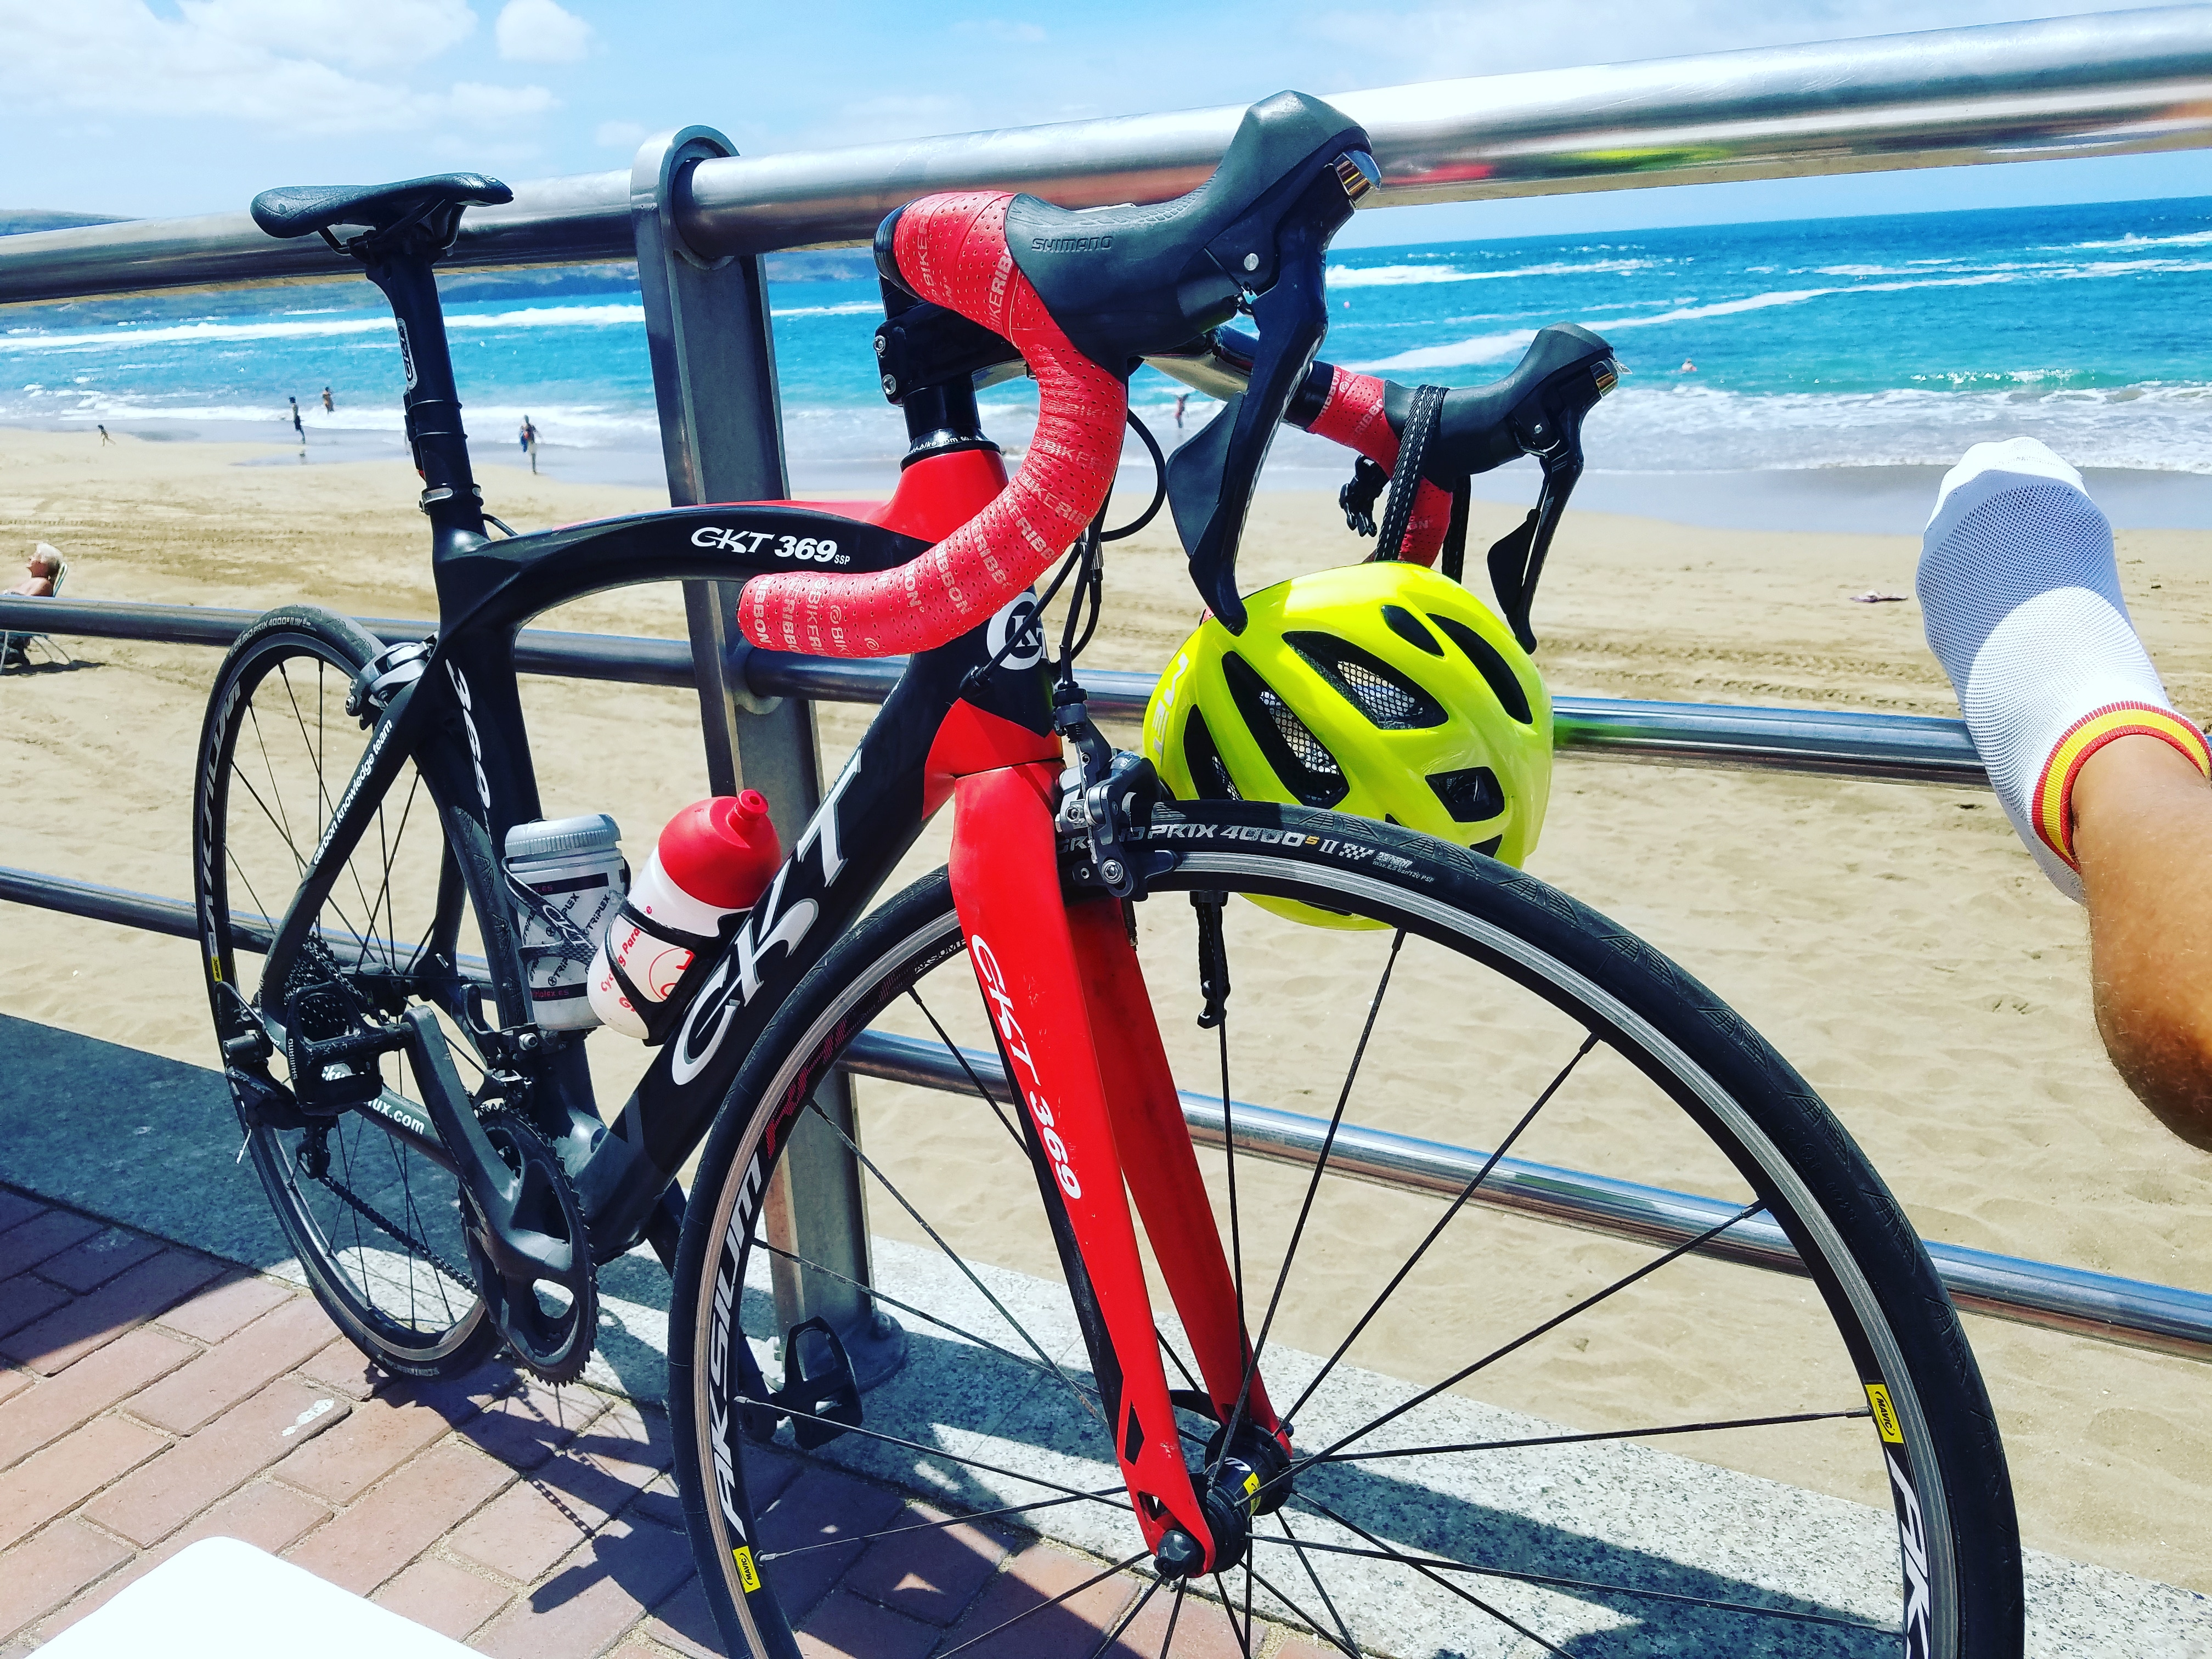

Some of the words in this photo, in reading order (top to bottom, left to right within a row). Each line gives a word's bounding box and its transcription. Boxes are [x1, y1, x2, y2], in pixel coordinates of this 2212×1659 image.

[1031, 235, 1113, 254] SHIMANO
[774, 535, 838, 562] 369
[834, 554, 850, 565] SSP
[313, 820, 337, 865] carbon
[337, 753, 375, 823] knowledge
[373, 719, 393, 755] team
[1147, 823, 1218, 839] PRIX
[288, 1038, 298, 1080] SHIMANO
[1030, 1091, 1081, 1199] 369
[709, 1152, 763, 1542] AKSIUM
[1876, 1397, 1893, 1430] MAVIC
[741, 1558, 753, 1580] MAVIC
[1886, 1447, 1930, 1659] AK
